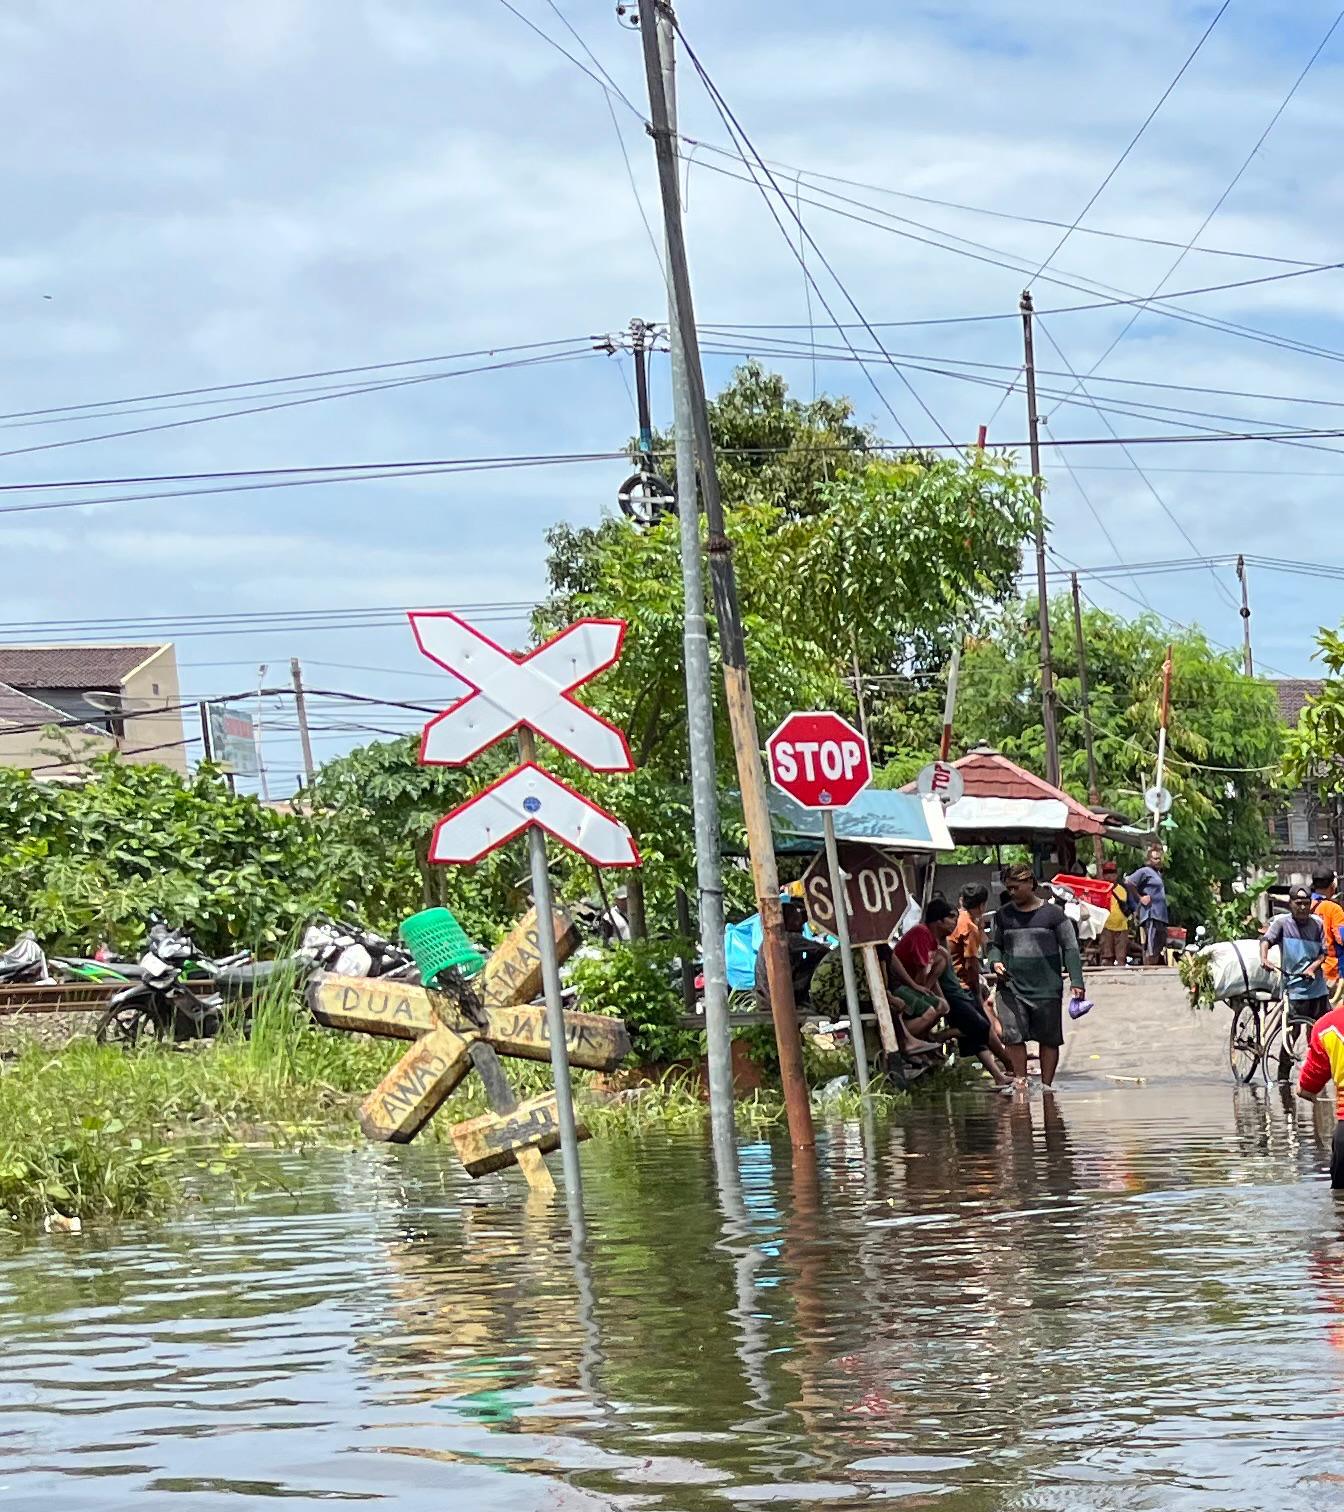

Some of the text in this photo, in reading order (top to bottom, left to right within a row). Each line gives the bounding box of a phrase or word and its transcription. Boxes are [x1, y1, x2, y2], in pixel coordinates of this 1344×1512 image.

[774, 740, 861, 783] STOP
[809, 866, 899, 920] STOP
[342, 986, 413, 1021] DUA
[381, 1048, 447, 1124] AWAS
